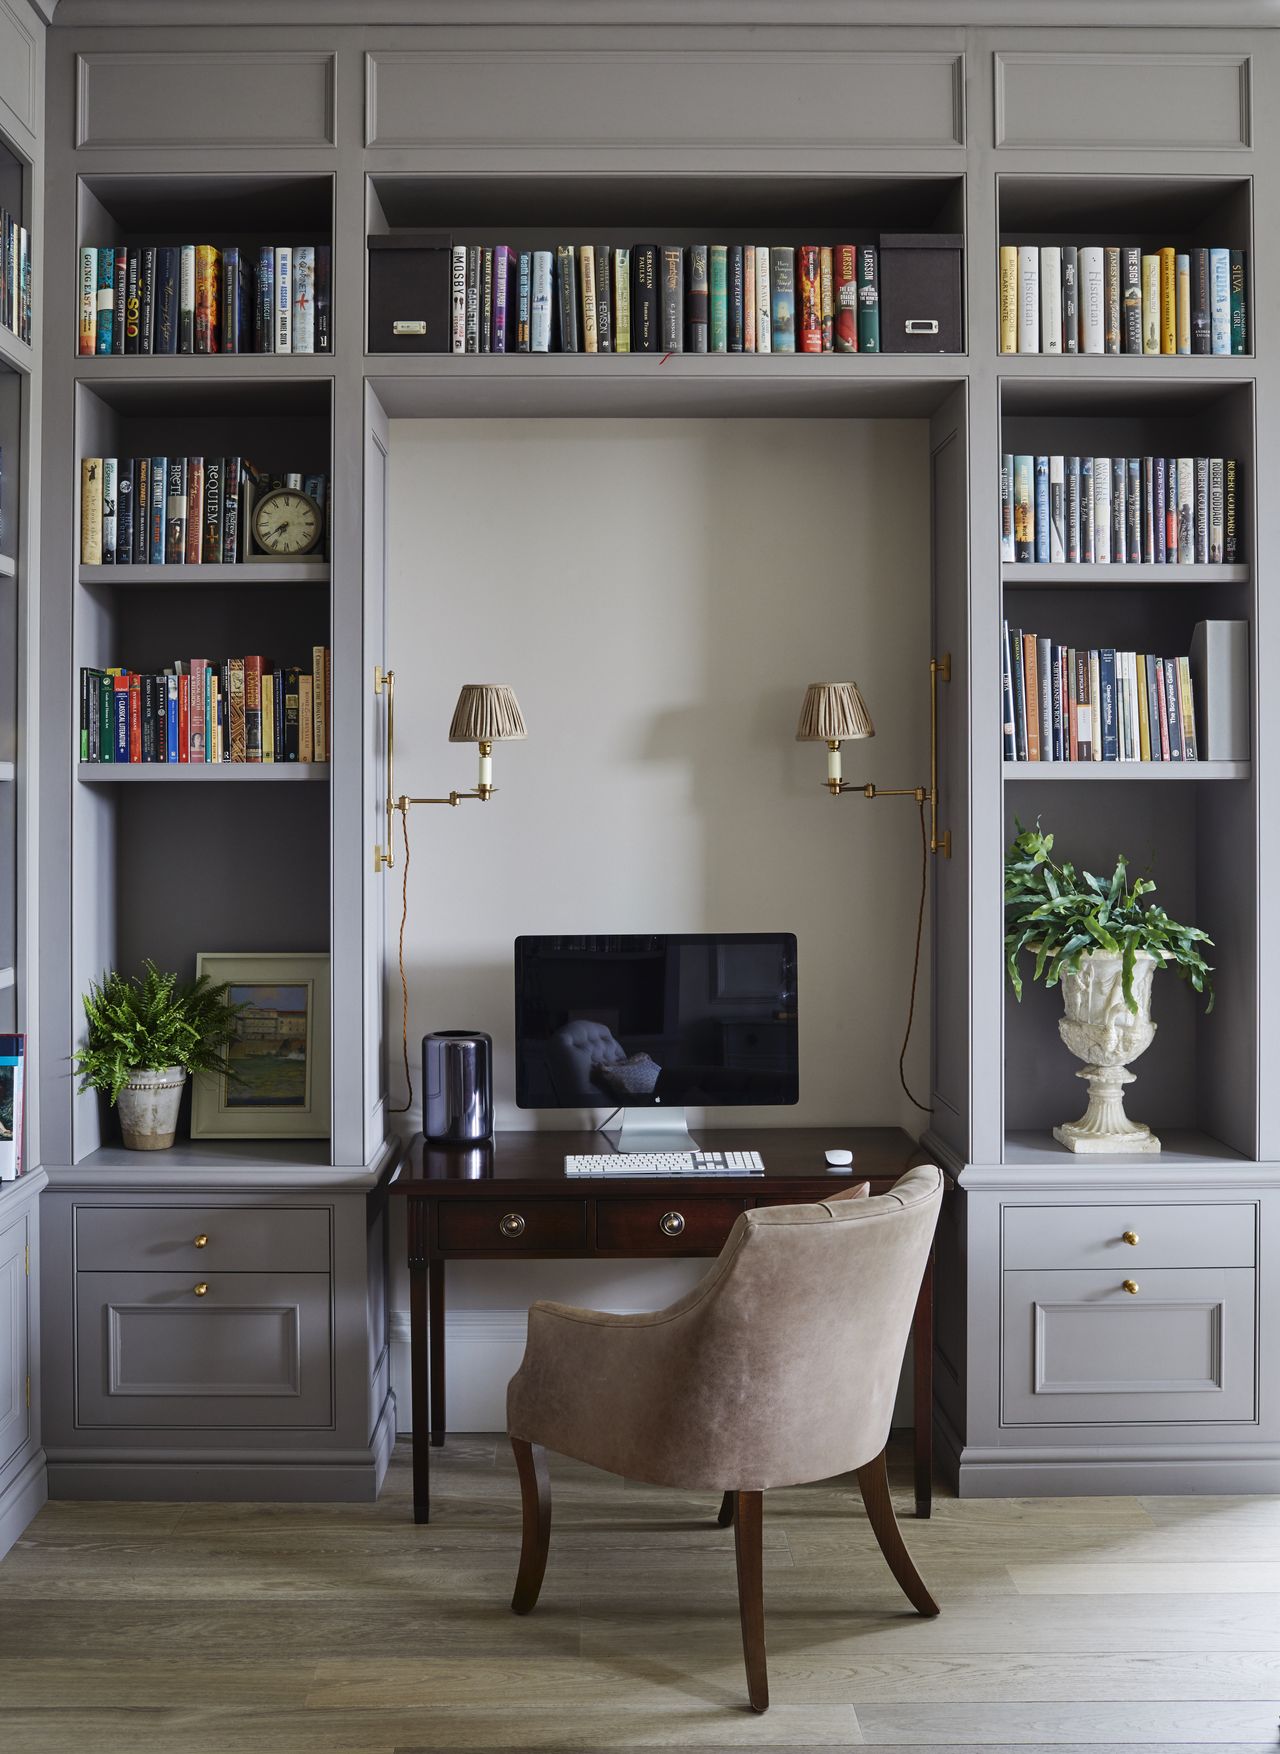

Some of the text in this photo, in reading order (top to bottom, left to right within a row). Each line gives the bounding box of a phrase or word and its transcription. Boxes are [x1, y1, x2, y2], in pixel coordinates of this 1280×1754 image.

[84, 254, 92, 308] GOING EAST
[454, 256, 464, 295] MOSBY
[484, 274, 491, 284] AT
[842, 248, 852, 280] LARSSON
[864, 250, 874, 281] LARSSON
[1129, 250, 1138, 285] THE SIGN
[1232, 264, 1242, 294] SILVA
[484, 284, 490, 294] LA
[520, 255, 528, 322] death on the marais
[1010, 282, 1016, 292] UP
[1024, 271, 1037, 327] Historian
[1089, 271, 1102, 328] Historian
[127, 297, 140, 338] SOLO
[467, 287, 477, 339] GARNETHILL
[585, 296, 594, 332] RELICS
[154, 466, 164, 508] JOHN CONNOLLY
[1198, 461, 1207, 536] ROBERT GODDARD
[1212, 462, 1222, 527] ROBERT GODDARD
[1227, 461, 1236, 536] ROBERT GODDARD
[1166, 662, 1174, 685] Gallery
[118, 700, 126, 748] CLASSICAL LITERATURE
